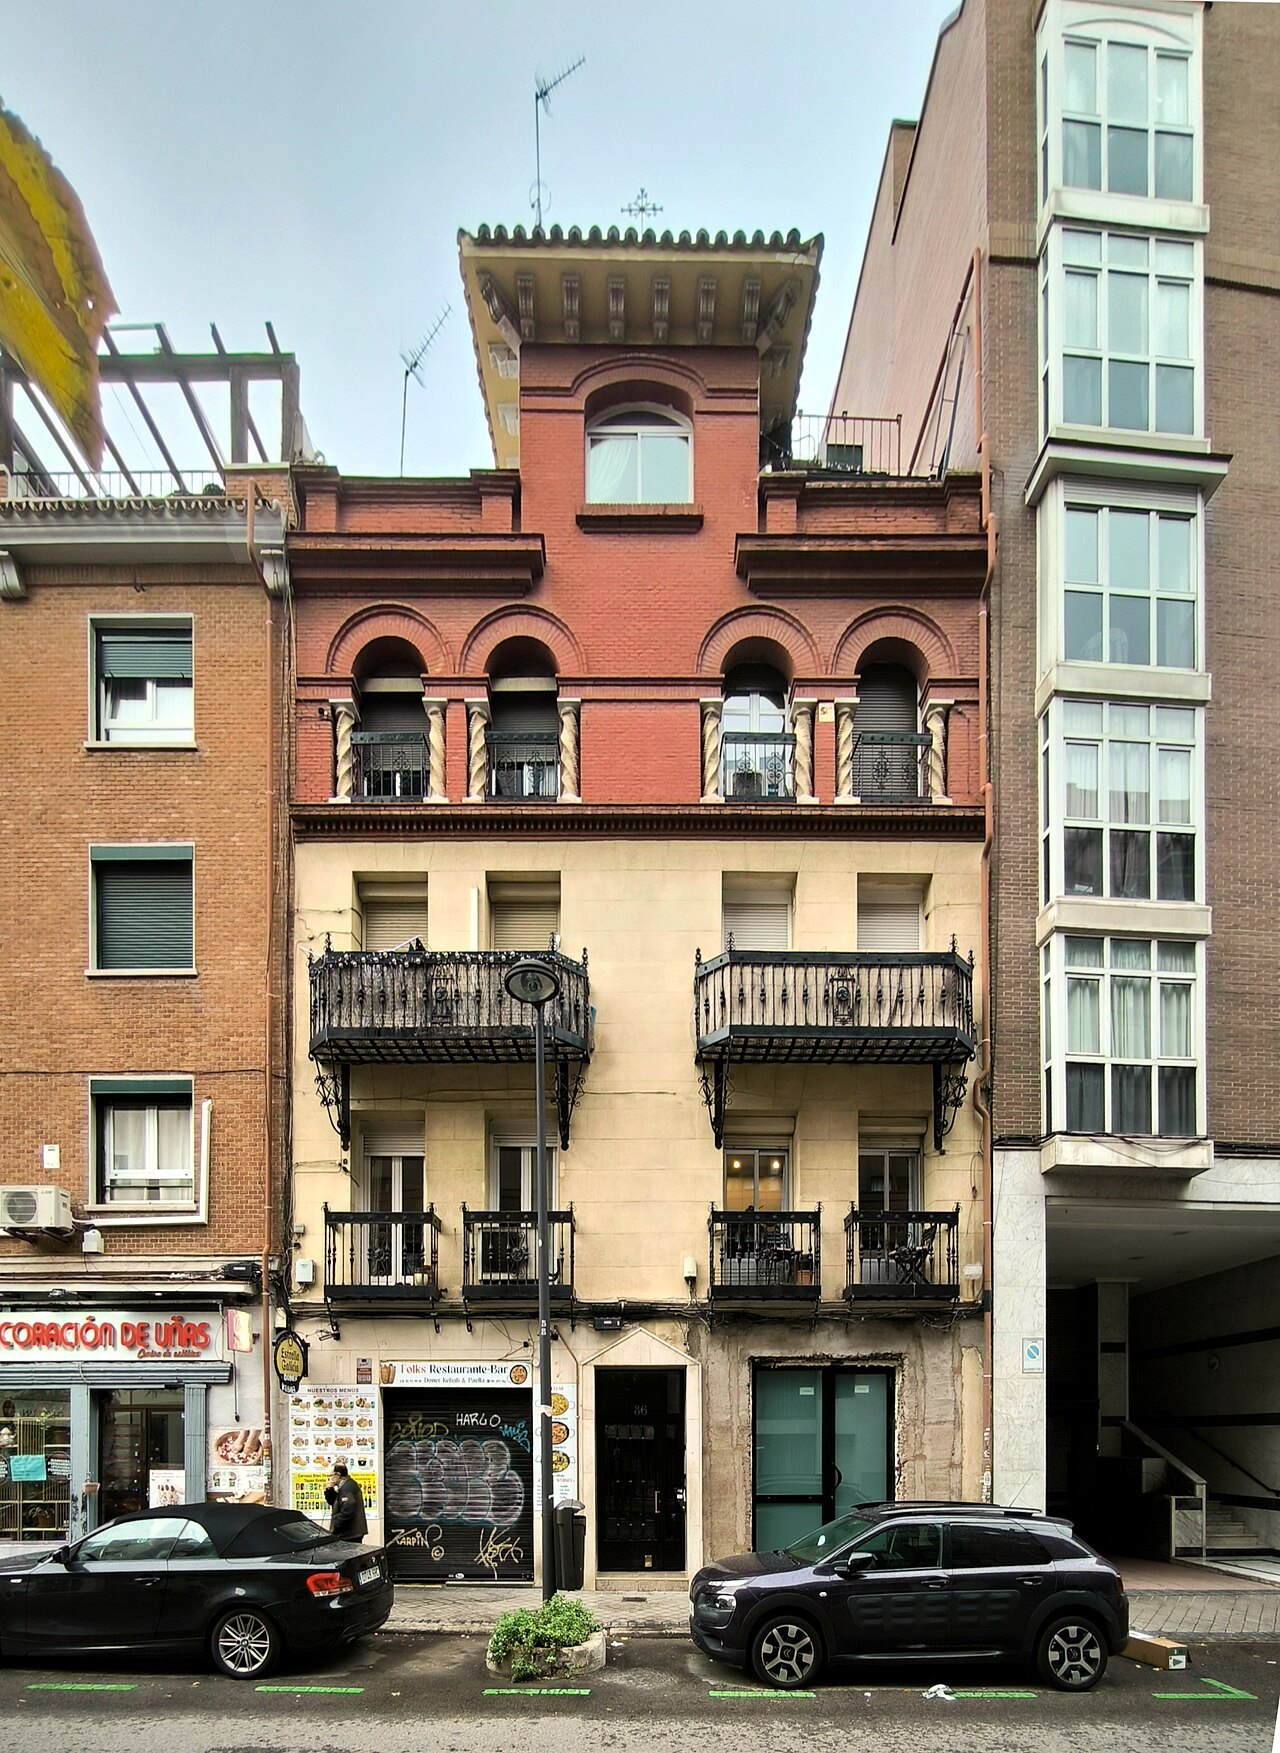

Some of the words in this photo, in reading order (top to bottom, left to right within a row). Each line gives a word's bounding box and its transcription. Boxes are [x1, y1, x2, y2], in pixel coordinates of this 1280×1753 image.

[121, 1322, 149, 1347] DE
[400, 1364, 426, 1374] Folks
[429, 1364, 508, 1374] Restaurante-Bar
[634, 1404, 648, 1416] 86
